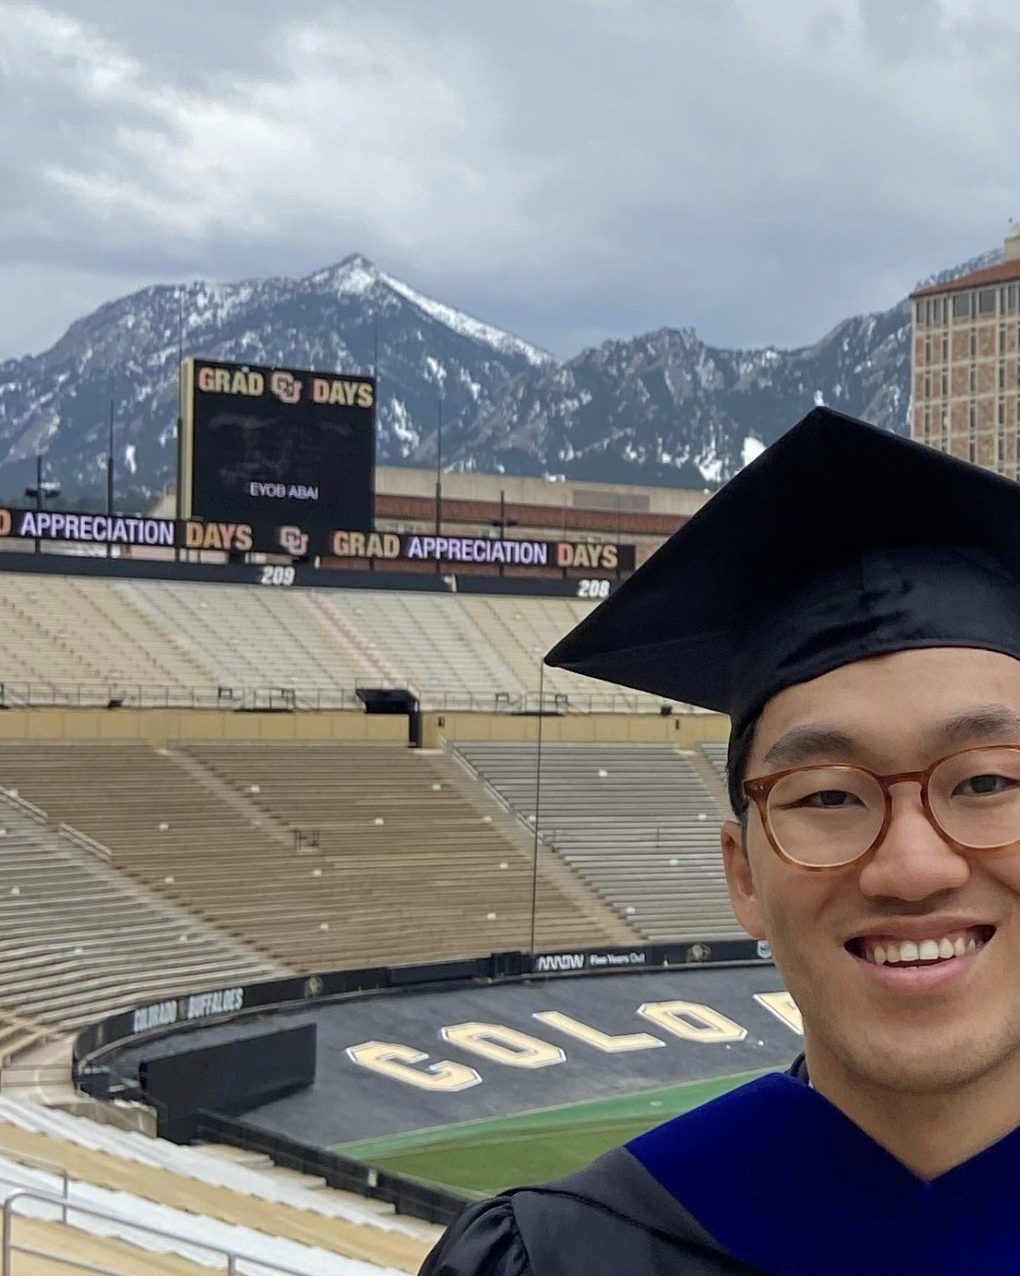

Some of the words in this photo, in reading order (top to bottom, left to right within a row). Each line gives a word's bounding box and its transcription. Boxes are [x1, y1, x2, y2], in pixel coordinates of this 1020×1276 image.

[198, 368, 265, 397] GRAD
[313, 378, 373, 408] DAYS
[20, 511, 175, 545] APPRECIATION
[186, 520, 253, 550] DAYS
[333, 530, 400, 559] GRAD
[407, 536, 548, 565] APPRECIATION
[557, 542, 619, 569] DAYS
[261, 566, 296, 586] 209
[577, 578, 611, 598] 208
